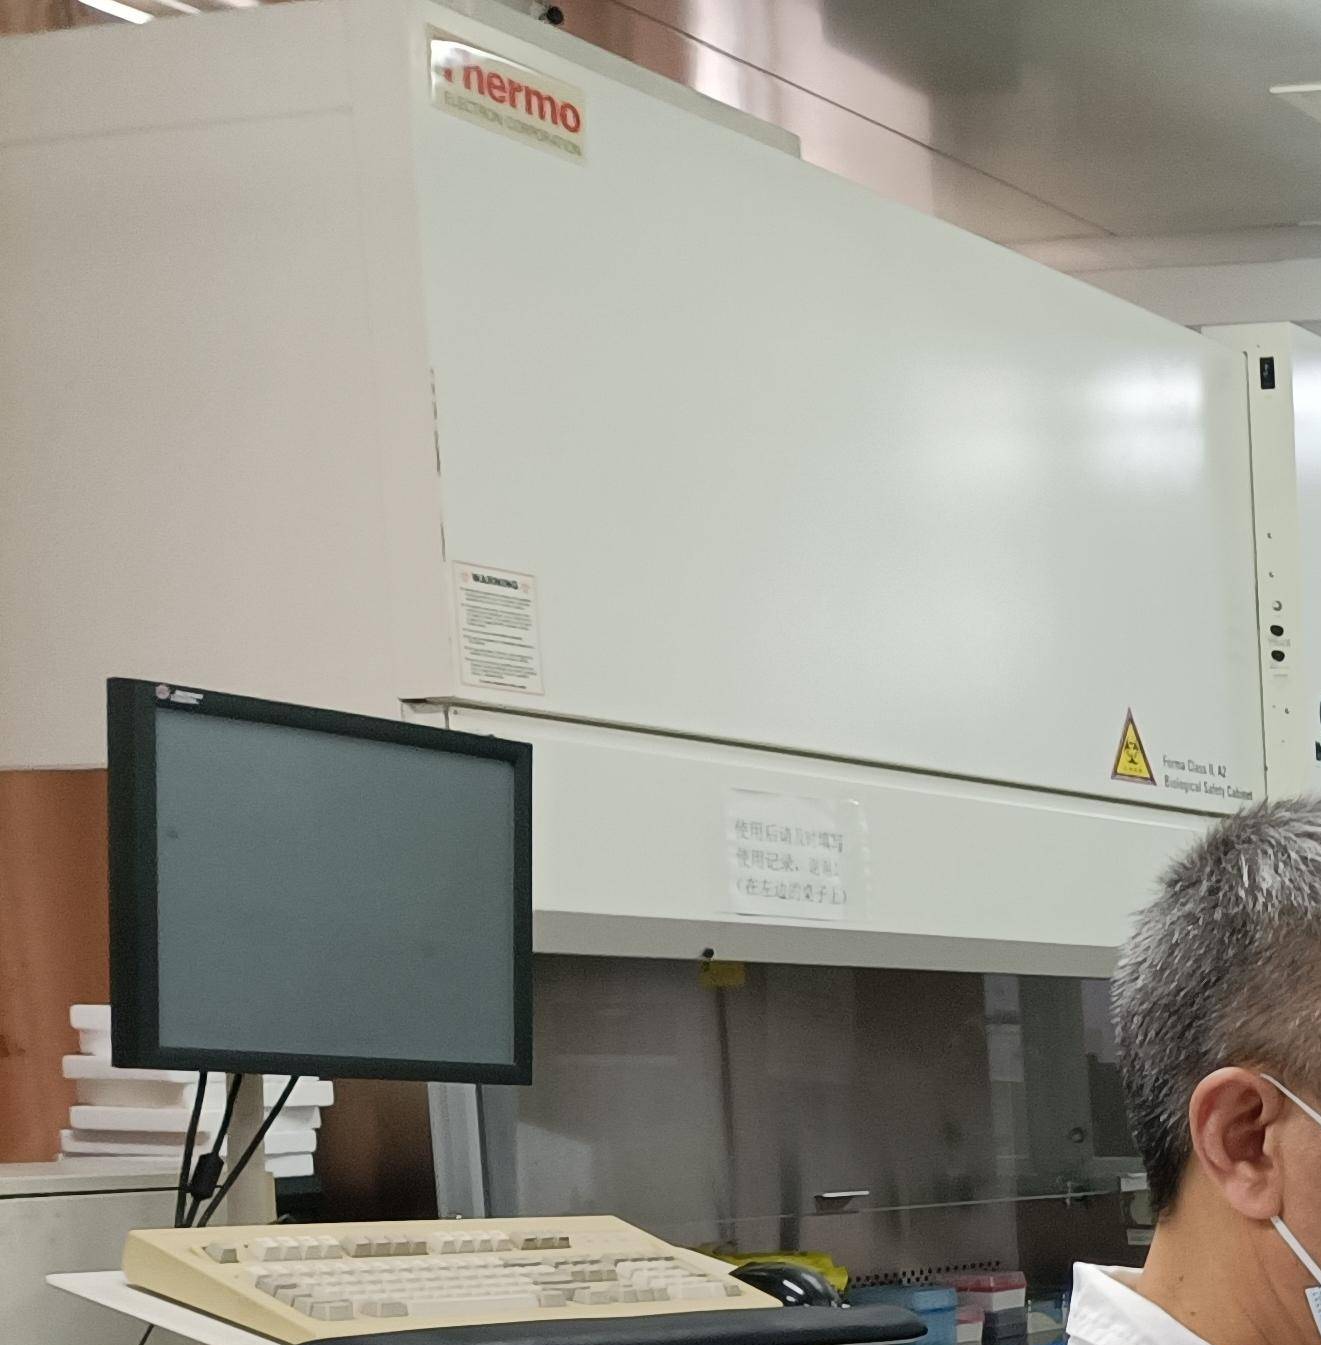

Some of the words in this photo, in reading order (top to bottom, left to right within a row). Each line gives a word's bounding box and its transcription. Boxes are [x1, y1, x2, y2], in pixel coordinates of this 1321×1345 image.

[1162, 755, 1185, 771] Forma
[1188, 759, 1207, 775] Class
[1218, 765, 1227, 778] A2
[1164, 774, 1201, 793] Biological
[1204, 781, 1225, 798] Safety
[1227, 785, 1253, 800] Cabinet
